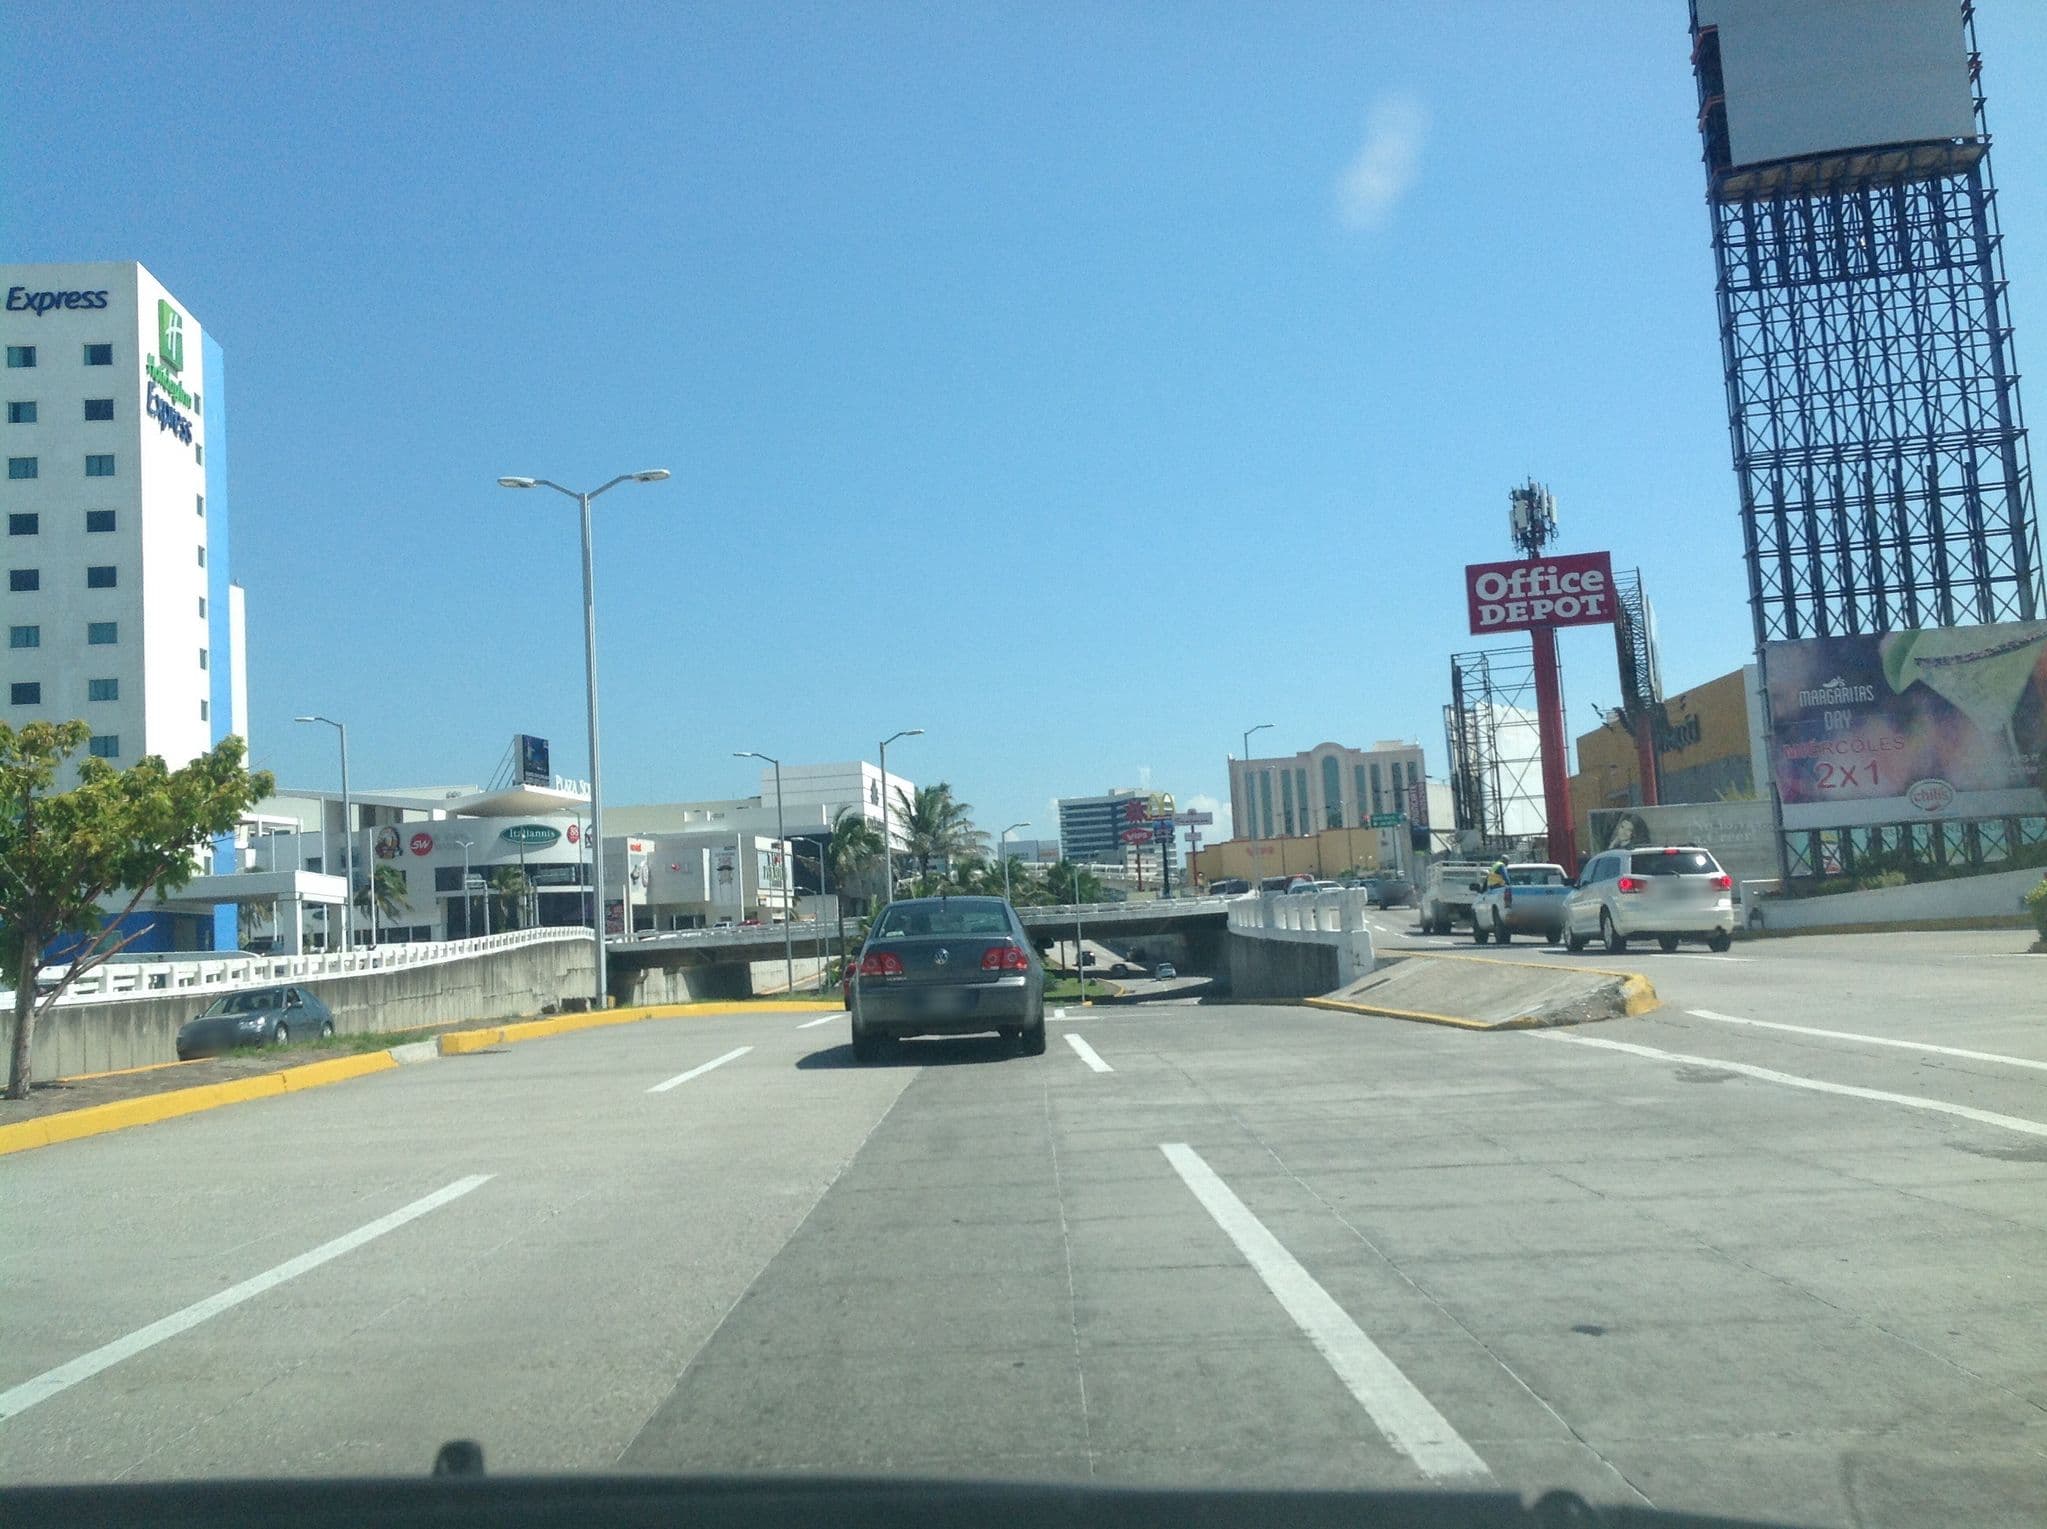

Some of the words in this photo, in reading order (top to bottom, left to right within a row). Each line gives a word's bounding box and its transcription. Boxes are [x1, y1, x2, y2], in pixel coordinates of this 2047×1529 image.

[6, 286, 108, 317] Express
[146, 381, 192, 447] Express
[1475, 565, 1605, 601] Office
[1478, 594, 1605, 626] DEPOT
[1799, 684, 1875, 707] MARGARITAS
[1823, 709, 1852, 731] DAY
